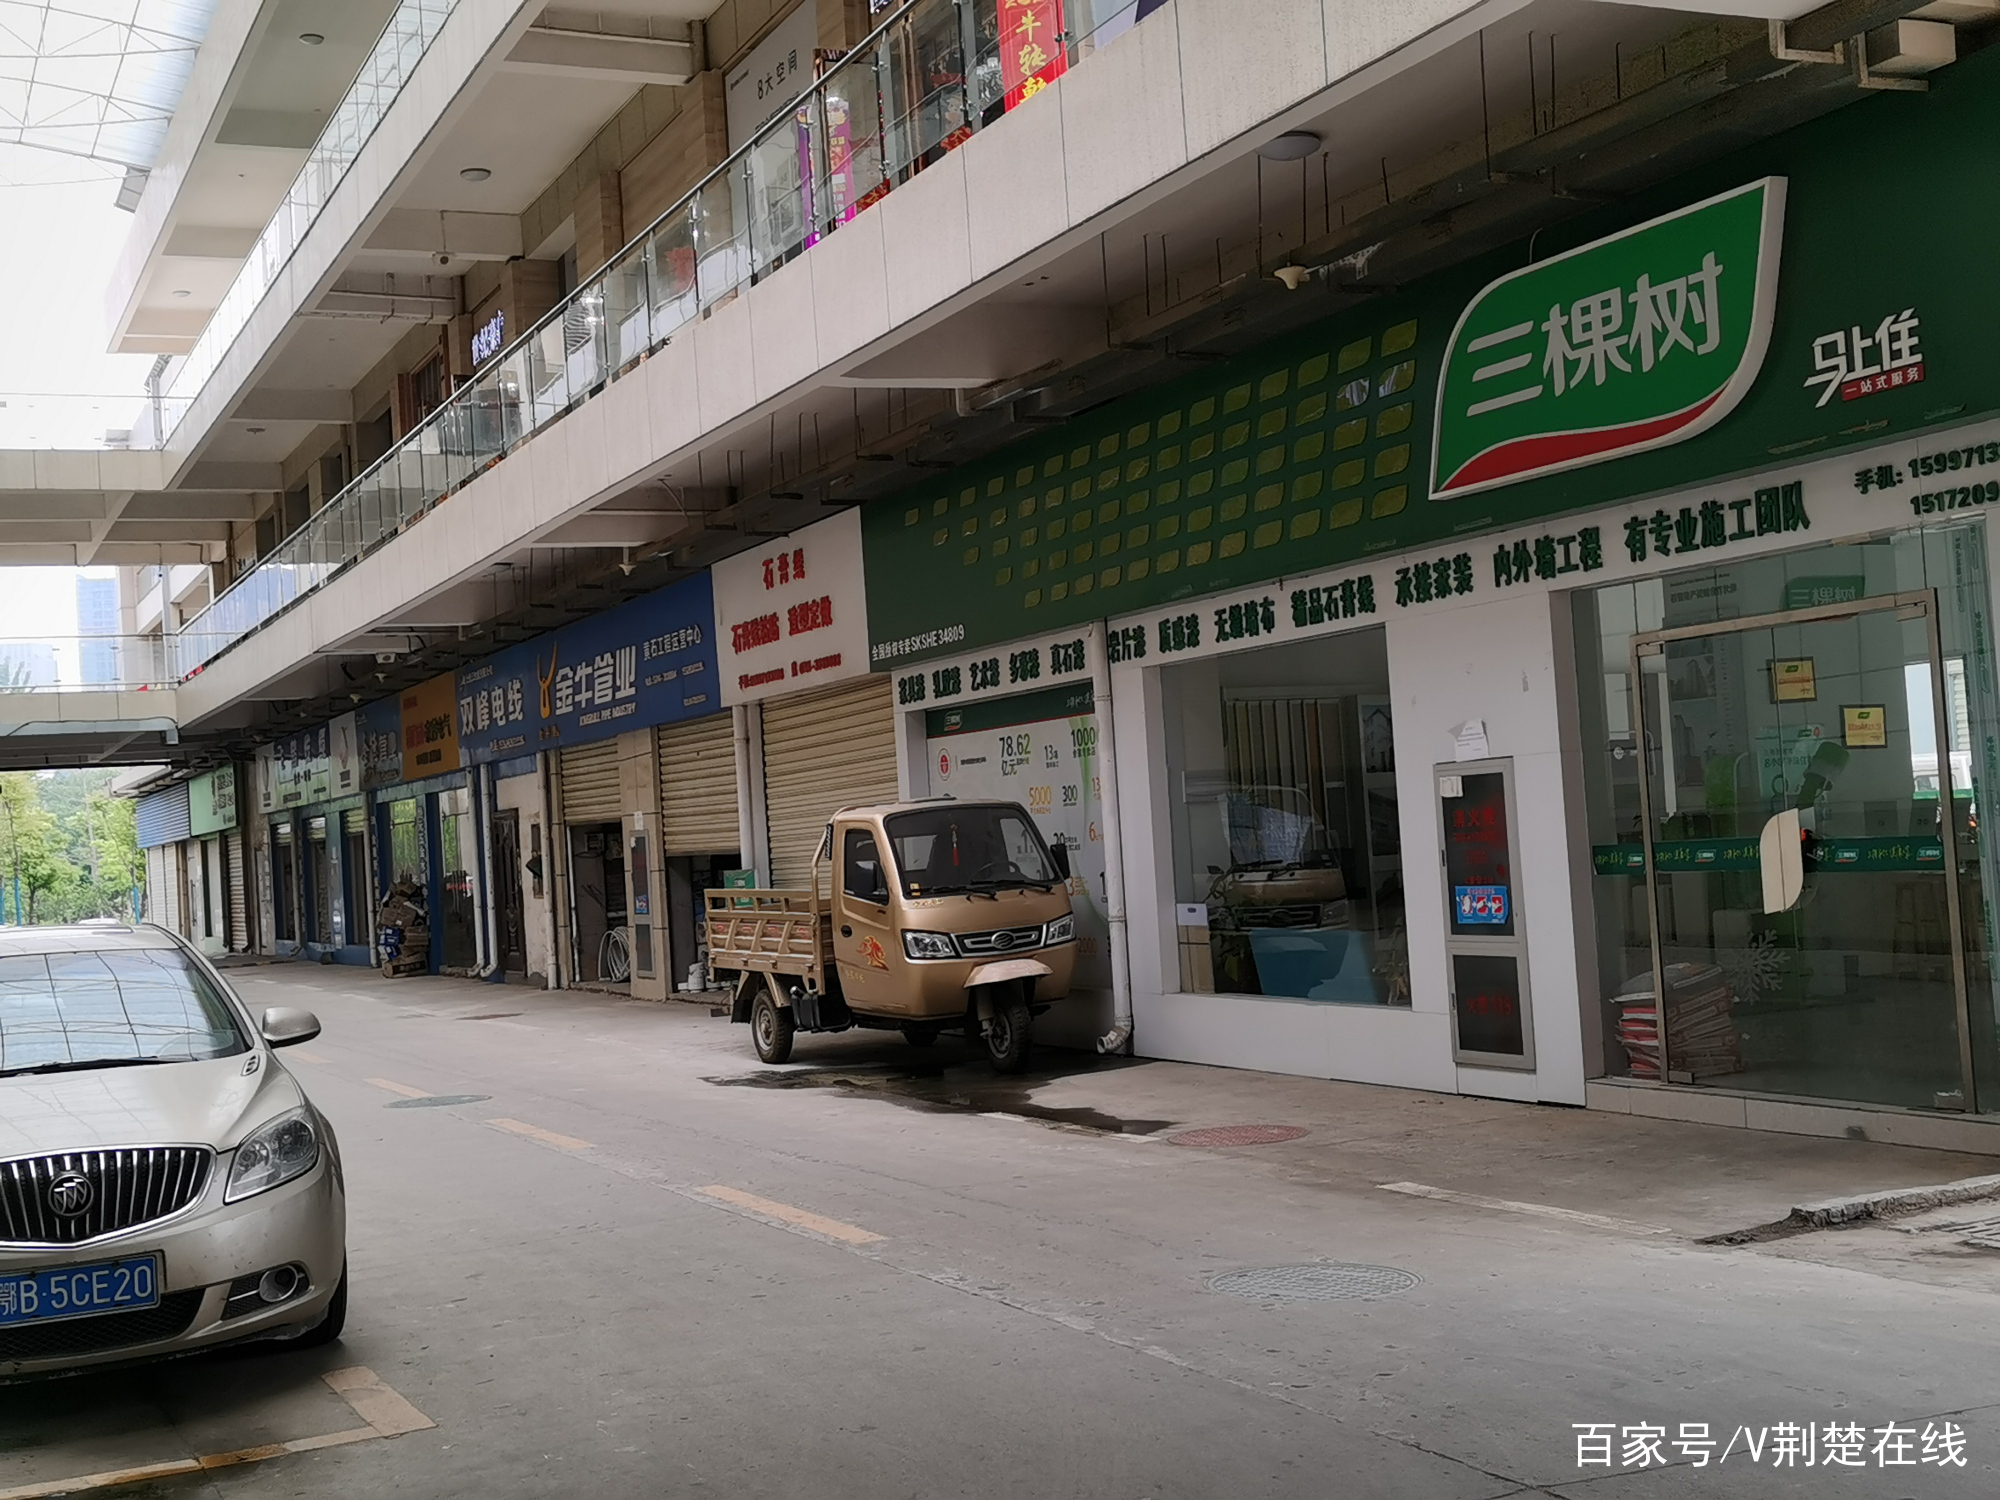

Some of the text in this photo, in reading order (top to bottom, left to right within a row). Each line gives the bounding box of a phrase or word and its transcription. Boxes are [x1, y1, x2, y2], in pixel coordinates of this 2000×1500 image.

[1467, 251, 1724, 417] 三棵树
[1803, 307, 1923, 408] 马上住
[1844, 367, 1919, 394] 一站式服务
[1908, 442, 2000, 478] 1599713
[1910, 480, 2000, 515] 1517209
[969, 658, 1000, 691] 艺术漆
[1050, 639, 1086, 675] 真石漆
[1158, 613, 1200, 653] 质感漆
[1394, 553, 1473, 607] 承接家装
[1493, 526, 1603, 588] 内外墙工程
[1623, 480, 1811, 563] 有专业施工团队
[555, 645, 636, 715] 金牛管业
[460, 678, 524, 737] 双峰电线
[999, 733, 1031, 758] 78.62
[1029, 786, 1052, 806] 5000
[1062, 785, 1078, 802] 300
